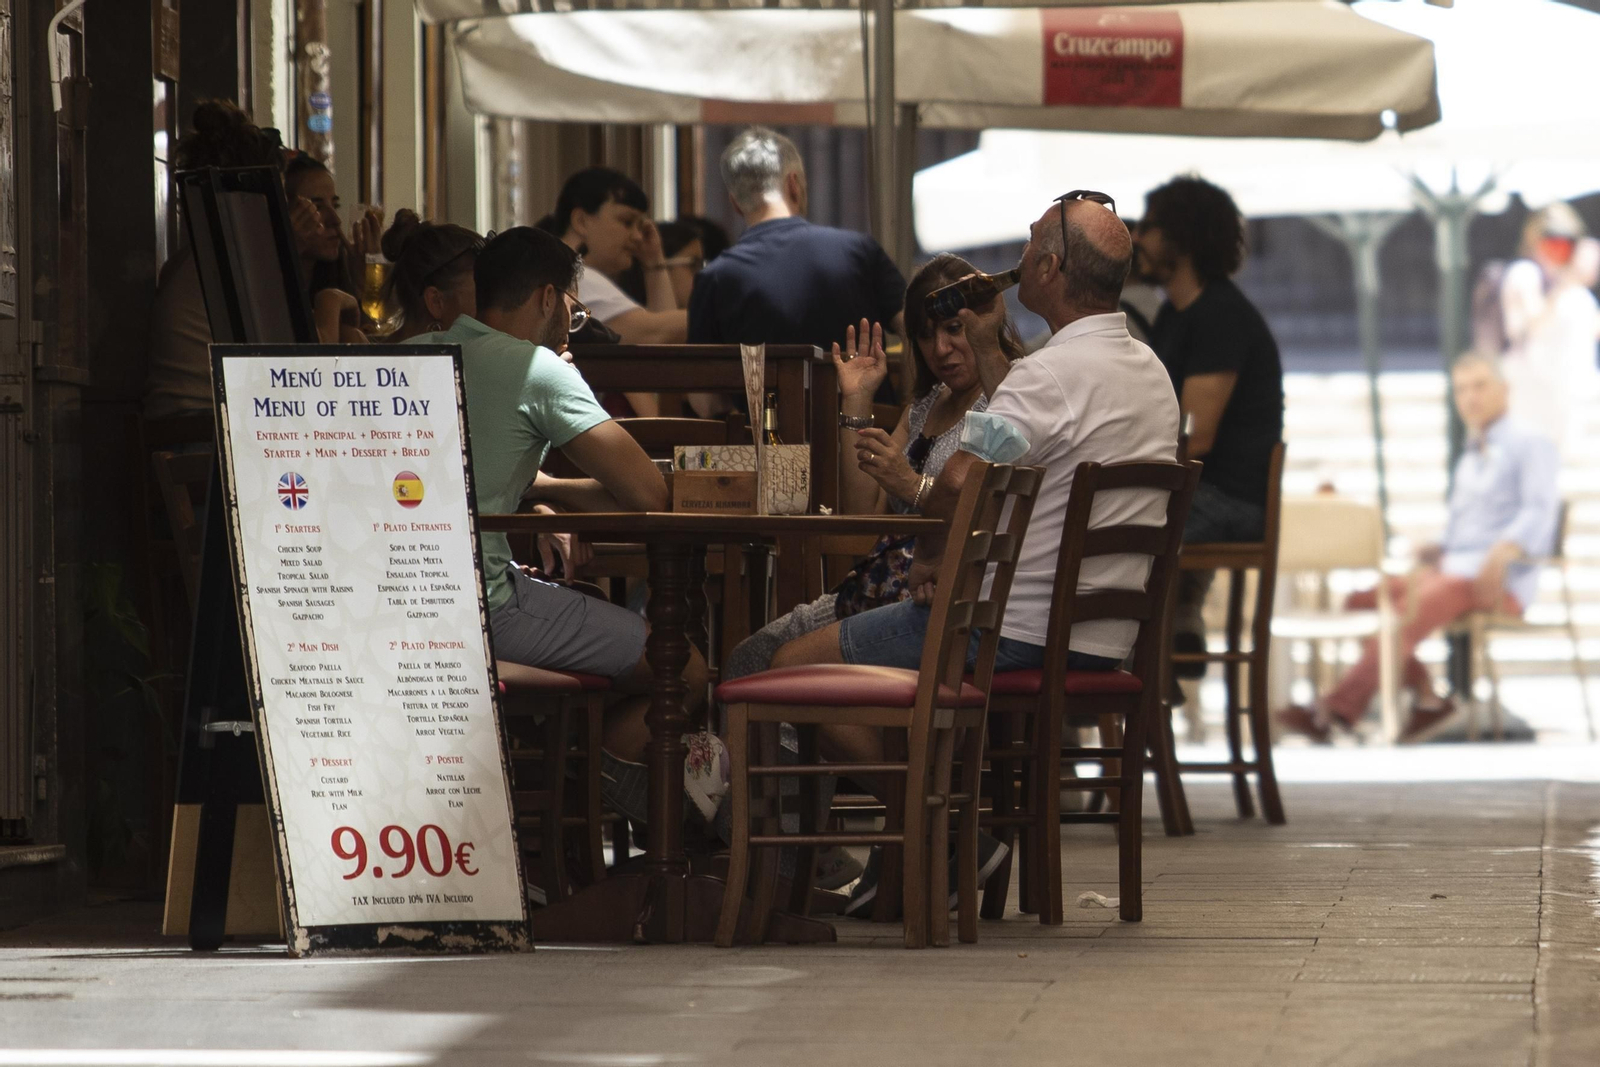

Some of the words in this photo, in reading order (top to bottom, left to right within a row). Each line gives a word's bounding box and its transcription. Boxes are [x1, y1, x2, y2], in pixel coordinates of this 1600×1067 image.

[1053, 32, 1173, 62] Cruzcampo
[270, 368, 322, 388] MENÚ
[334, 371, 366, 387] DEL
[376, 368, 409, 387] DÍA
[253, 398, 305, 417] MENU
[317, 401, 337, 416] OF
[348, 401, 382, 416] THE
[392, 397, 430, 416] DAY
[331, 824, 479, 880] 9.90€
[408, 895, 423, 904] 10%
[426, 895, 440, 903] IVA
